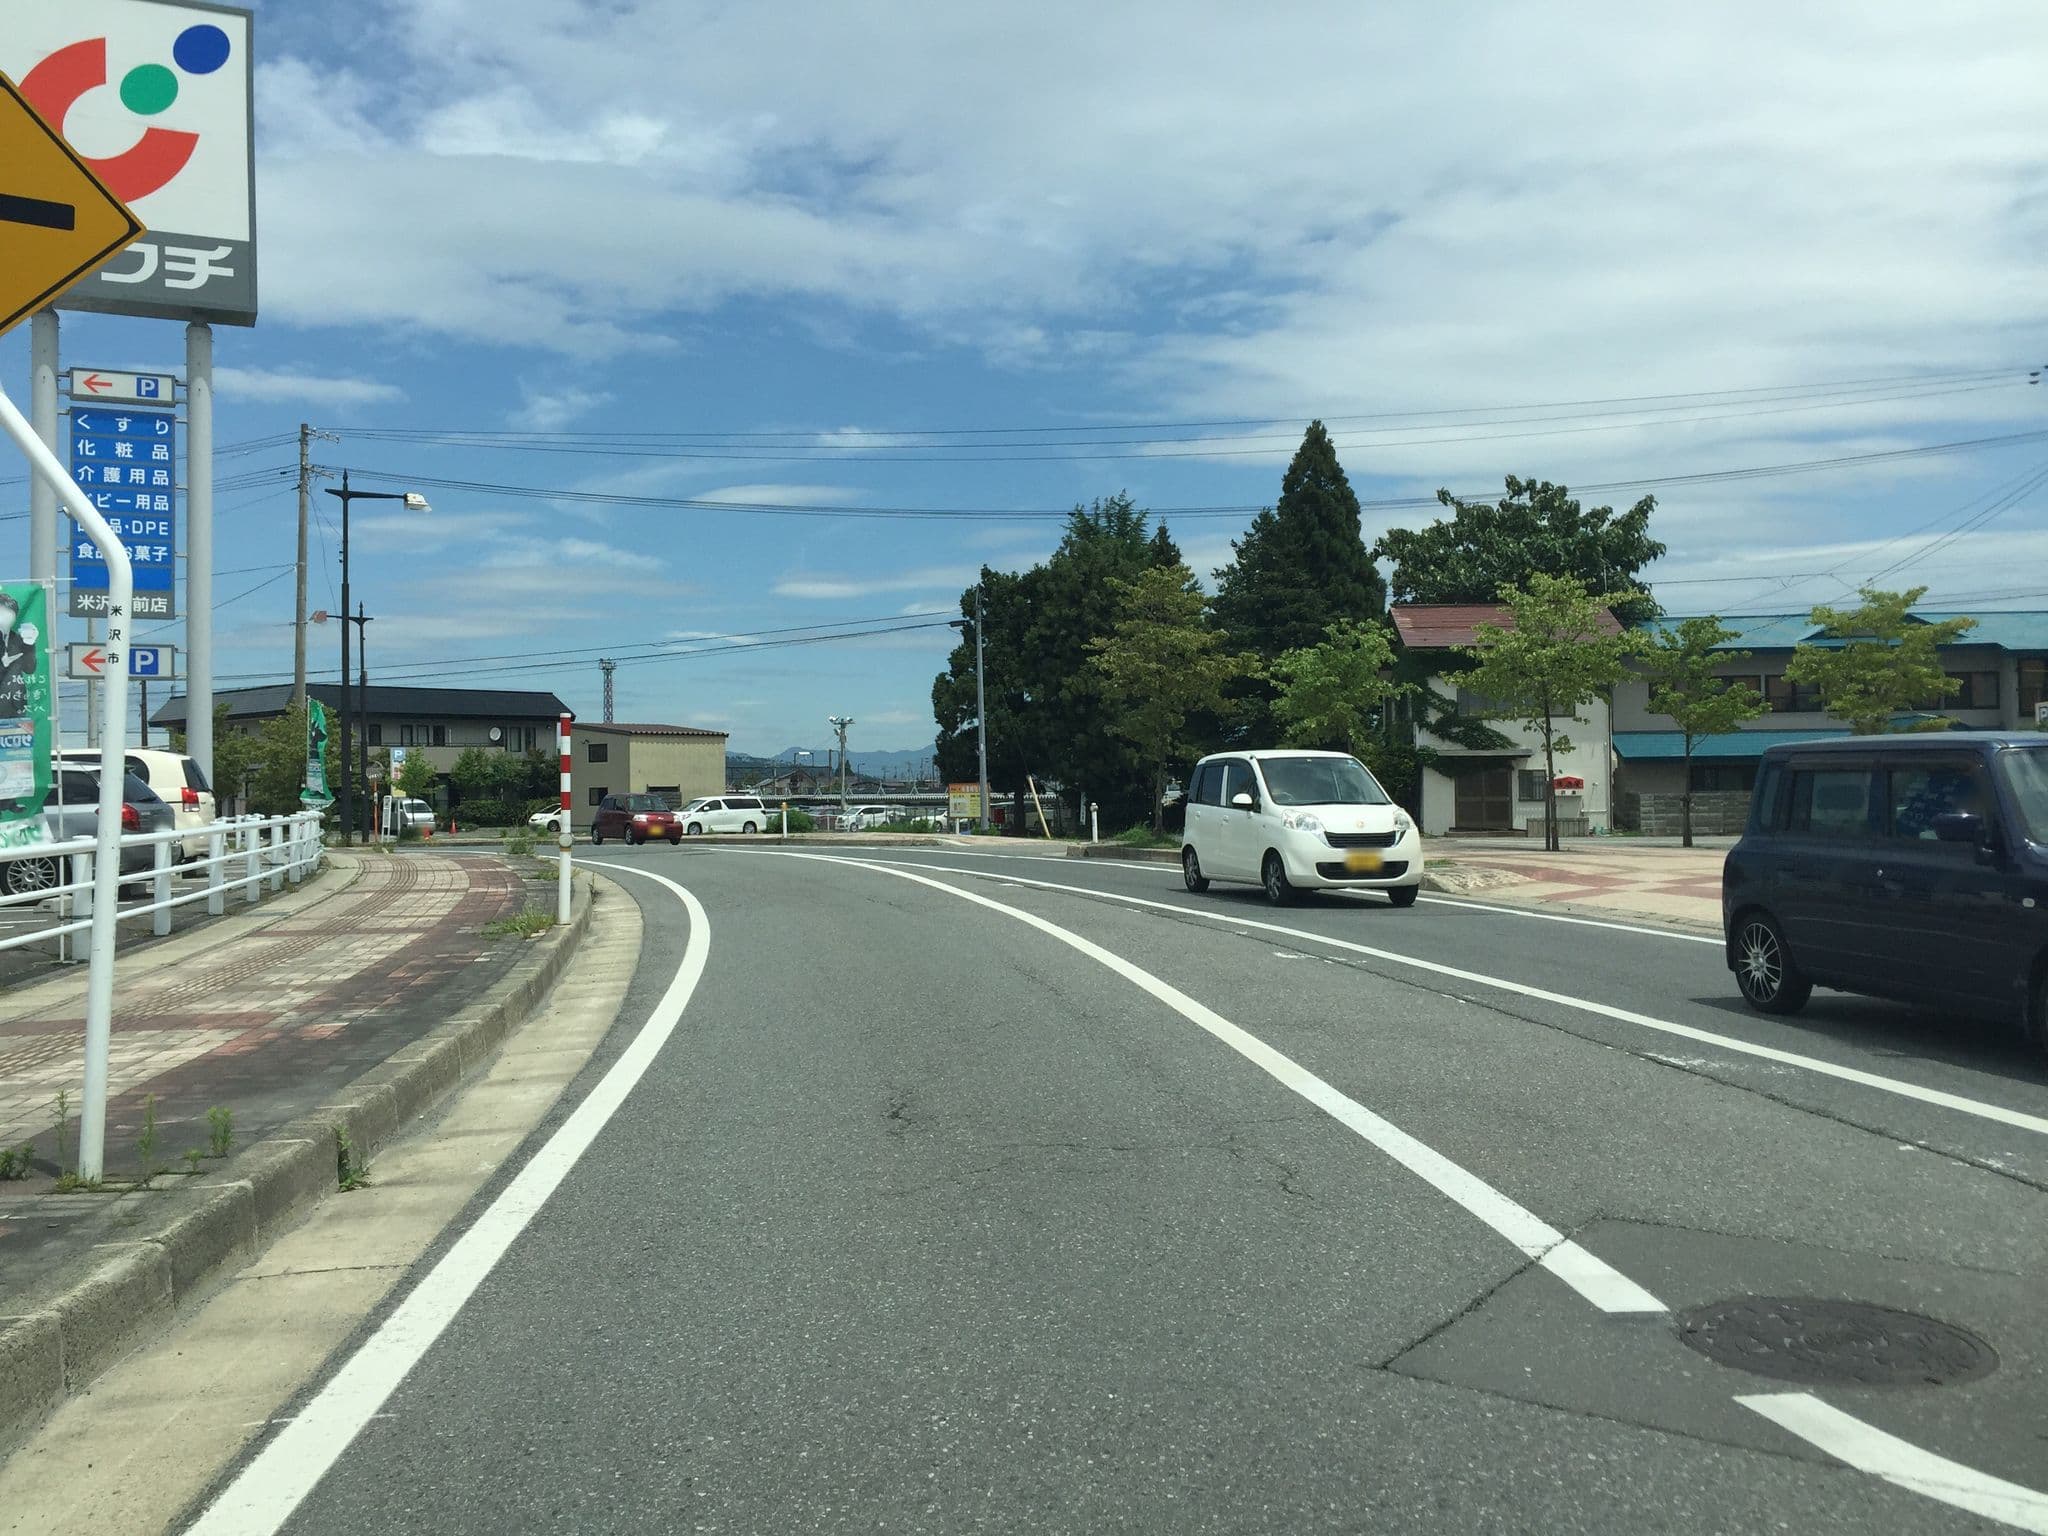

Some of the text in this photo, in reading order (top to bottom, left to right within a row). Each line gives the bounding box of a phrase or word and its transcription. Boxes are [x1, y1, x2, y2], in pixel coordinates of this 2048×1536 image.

[140, 380, 156, 397] P
[77, 413, 169, 436] くすり
[77, 439, 169, 461] 化粧品
[77, 465, 169, 486] 介護用品
[87, 493, 169, 511] ビー用品
[77, 518, 169, 536] 品・DPE
[77, 594, 168, 613] 米沢前店
[108, 605, 123, 664] 米沢市
[135, 650, 154, 673] P
[394, 749, 403, 759] P
